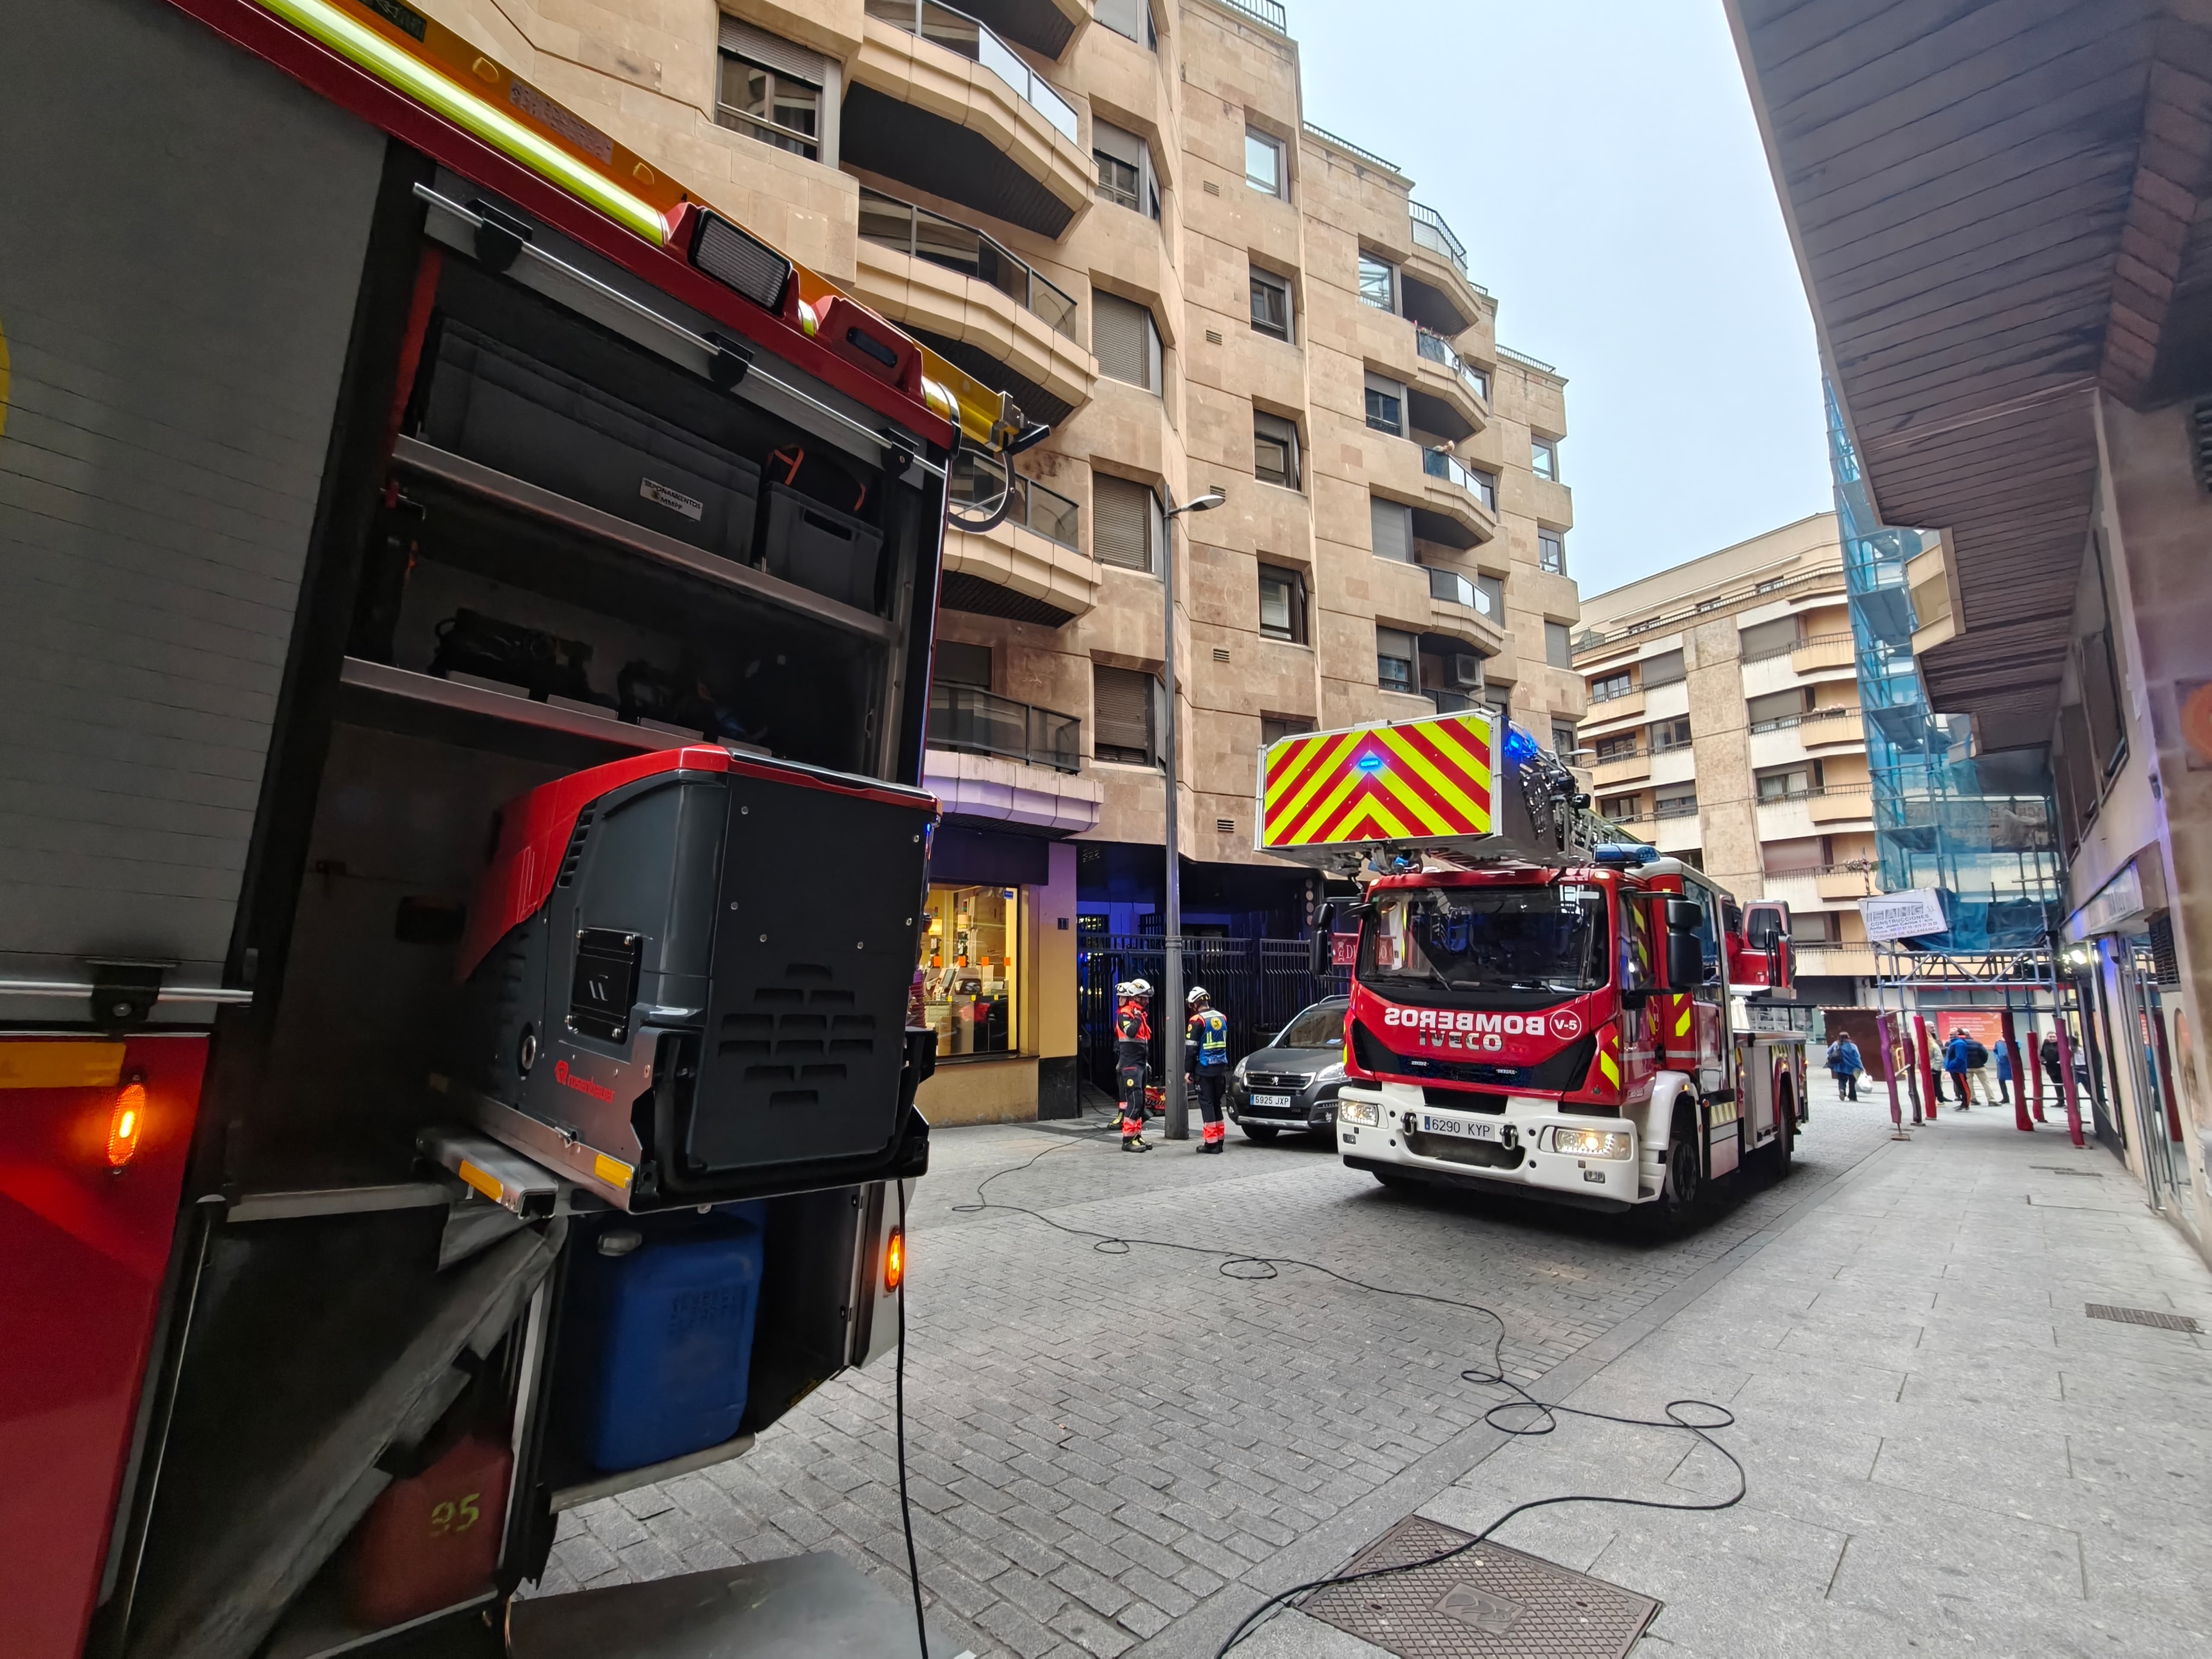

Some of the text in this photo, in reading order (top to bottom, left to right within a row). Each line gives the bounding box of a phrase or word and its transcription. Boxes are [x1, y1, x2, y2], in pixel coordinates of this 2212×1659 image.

[1871, 914, 1929, 927] CONSTRUCCIONES
[1554, 1020, 1578, 1030] V-5
[1419, 1029, 1503, 1052] IVECO
[1255, 1096, 1273, 1104] 5925
[1432, 1119, 1490, 1136] 6290 KYP
